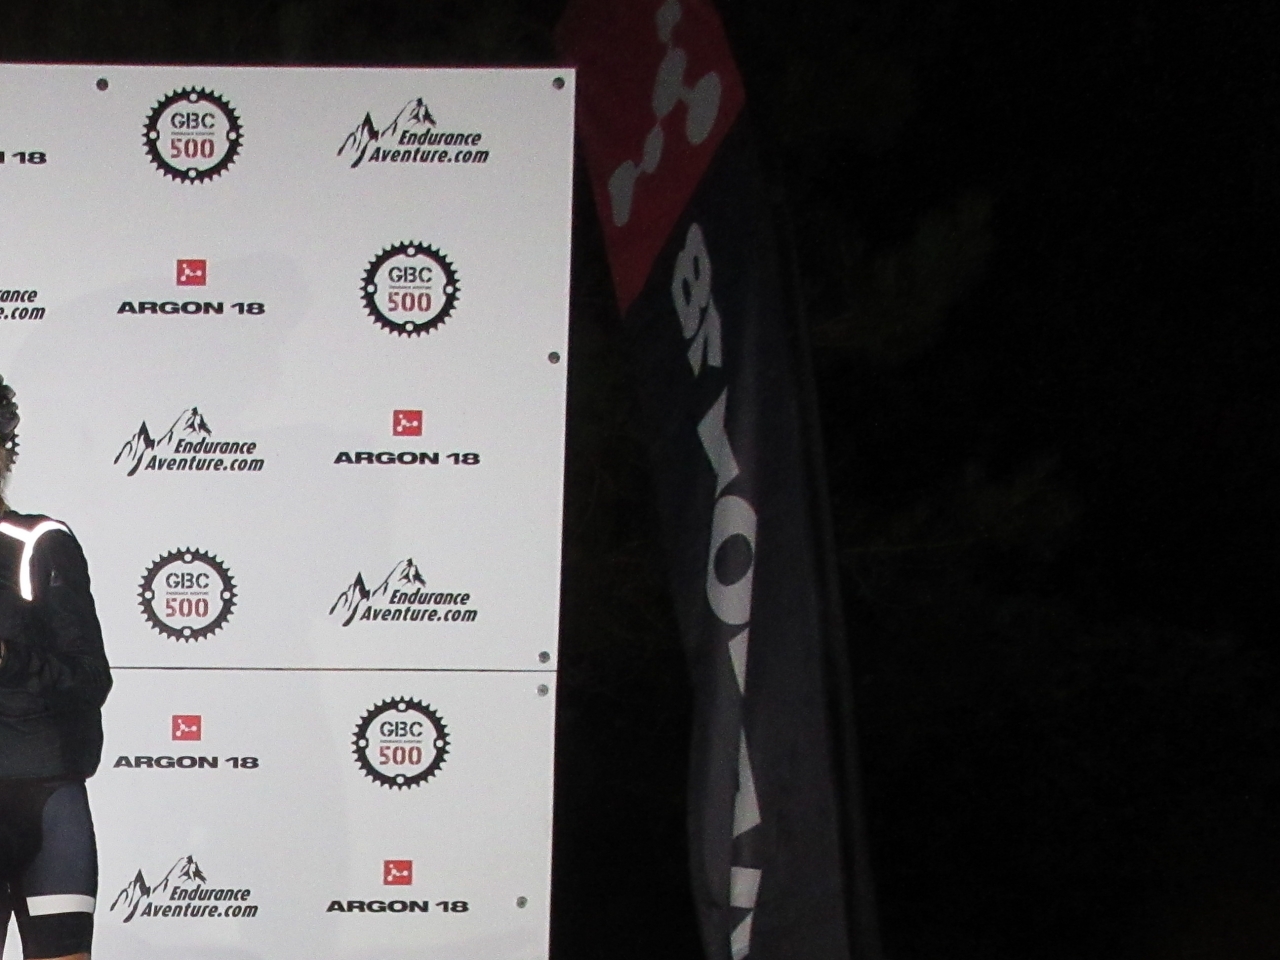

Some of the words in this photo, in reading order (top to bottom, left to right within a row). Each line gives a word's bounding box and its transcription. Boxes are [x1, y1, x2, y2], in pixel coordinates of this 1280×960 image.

[170, 112, 215, 129] GBC
[398, 127, 482, 146] Endurance
[170, 138, 215, 159] 500
[368, 147, 490, 164] Aventure.com
[11, 151, 47, 164] 18
[388, 266, 433, 283] GBC
[116, 301, 224, 315] ARGON
[230, 302, 266, 316] 18
[388, 292, 432, 312] 500
[174, 437, 257, 455] Endurance
[144, 454, 265, 472] Aventure.com
[333, 451, 440, 465] ARGON
[445, 452, 481, 466] 18
[165, 572, 210, 589] GBC
[388, 588, 471, 606] Endurance
[165, 598, 209, 618] 500
[359, 605, 478, 622] Aventure.com
[379, 721, 423, 737] GBC
[113, 755, 219, 769] ARGON
[224, 756, 260, 769] 18
[379, 745, 422, 765] 500
[168, 883, 251, 901] Endurance
[140, 901, 259, 918] Aventure.com
[326, 899, 429, 913] ARGON
[435, 900, 469, 913] 18
